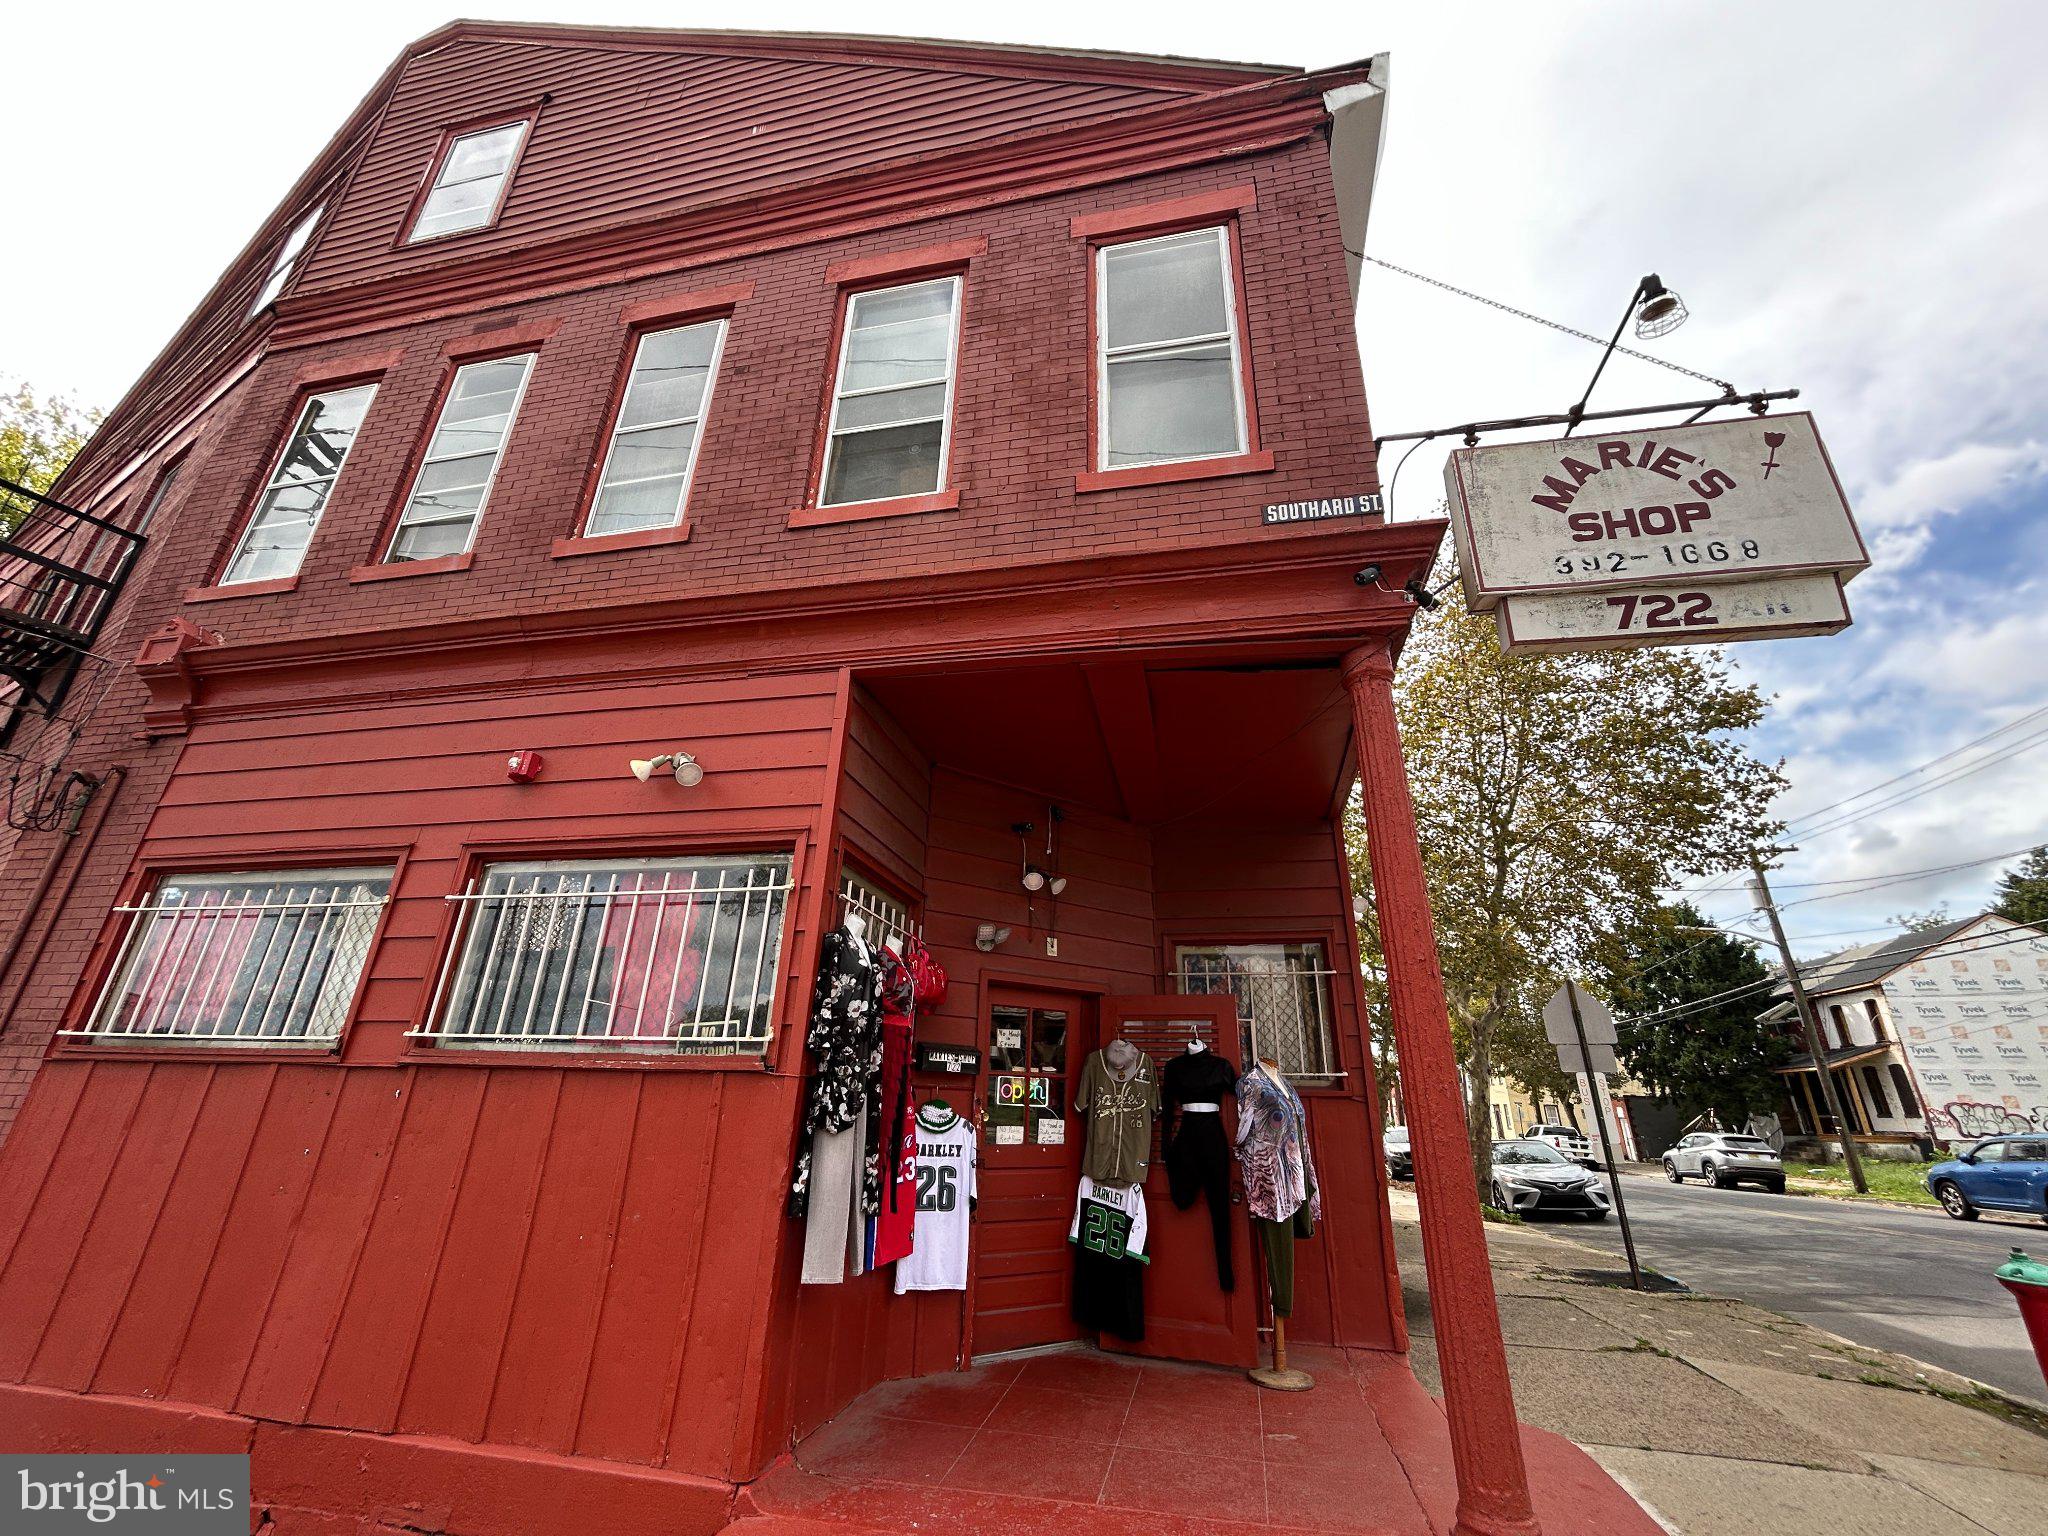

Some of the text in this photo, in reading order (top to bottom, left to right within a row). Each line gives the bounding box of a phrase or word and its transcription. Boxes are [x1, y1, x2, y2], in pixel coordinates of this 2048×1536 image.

[1531, 440, 1737, 514] MARIE'S
[1267, 494, 1382, 522] SOUTHARD ST.
[1568, 501, 1712, 542] SHOP
[1606, 592, 1719, 630] 722
[1910, 979, 1937, 987] Tyvek
[1953, 978, 1980, 987] Tyvek
[1995, 978, 2023, 986] Tyvek
[1916, 1006, 1943, 1014] Tyvek
[1958, 1005, 1986, 1014] Tyvek
[2001, 1005, 2030, 1013] Tyvek
[701, 1026, 716, 1044] NO
[1909, 1046, 1937, 1054] Tyvek
[1953, 1046, 1980, 1054] Tyvek
[1996, 1046, 2024, 1054] Tyvek
[1921, 1072, 1948, 1081] Tyvek
[1964, 1072, 1992, 1082] Tyvek
[2009, 1073, 2038, 1082] Tyvek
[1579, 1078, 1591, 1106] BUS
[1599, 1079, 1612, 1115] STOP
[916, 1165, 957, 1212] 26
[1092, 1185, 1123, 1206] BARKLEY
[1084, 1204, 1126, 1259] 26
